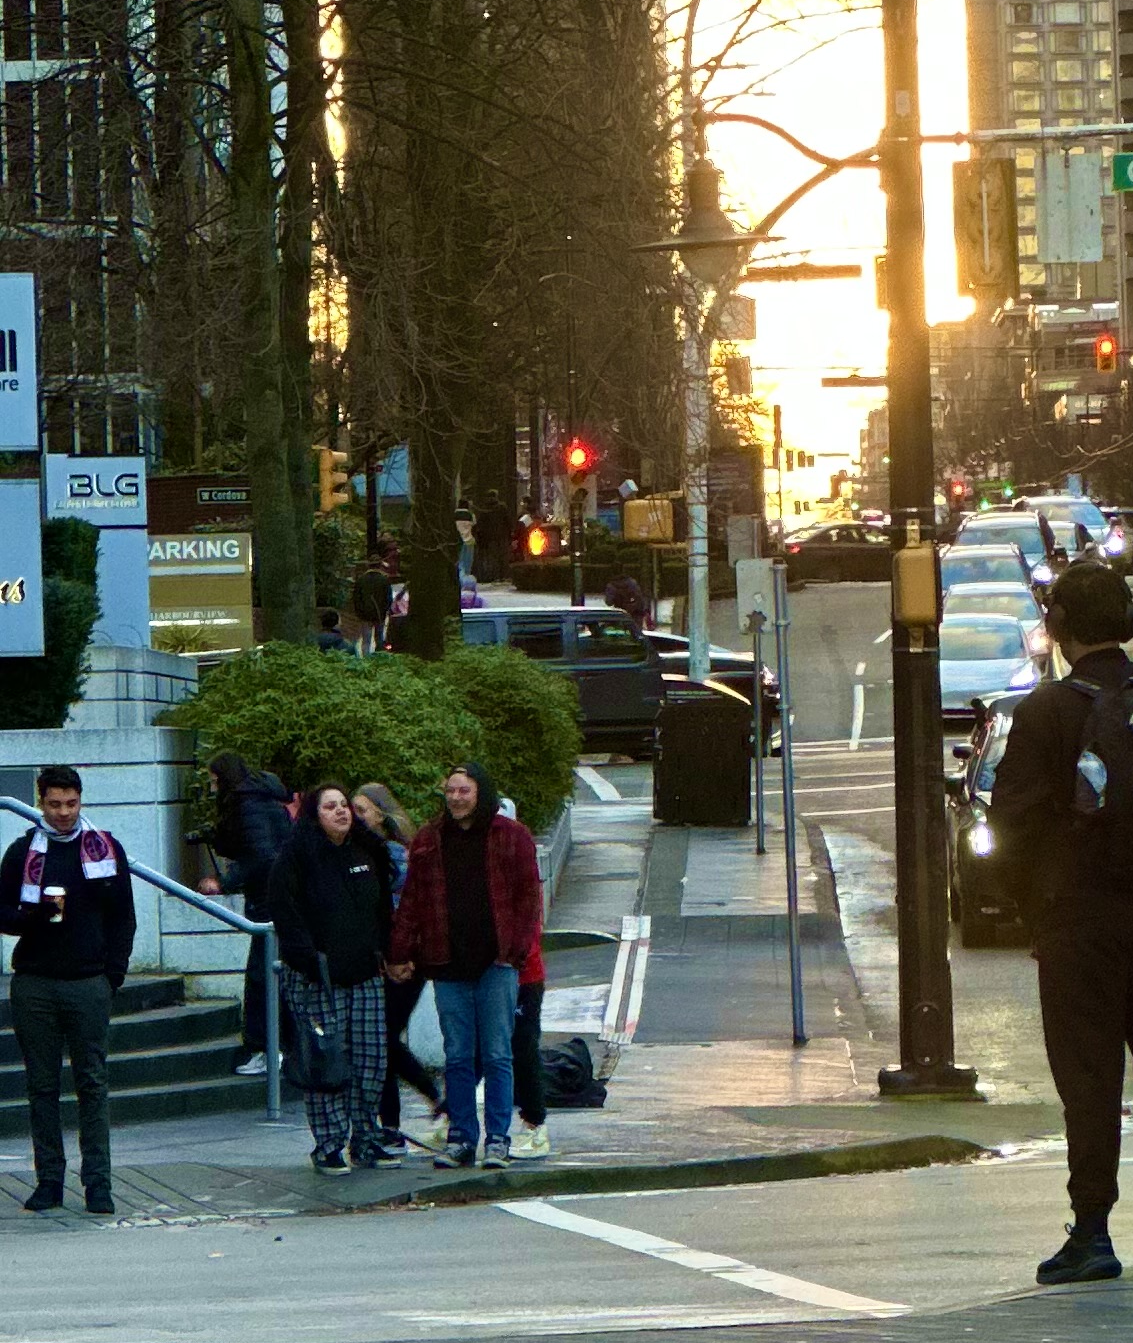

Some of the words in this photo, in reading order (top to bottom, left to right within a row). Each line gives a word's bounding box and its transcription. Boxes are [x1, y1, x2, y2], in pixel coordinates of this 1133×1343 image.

[0, 378, 19, 392] re
[67, 472, 140, 498] BLG
[211, 489, 248, 501] Cordova
[147, 538, 241, 561] ARKING
